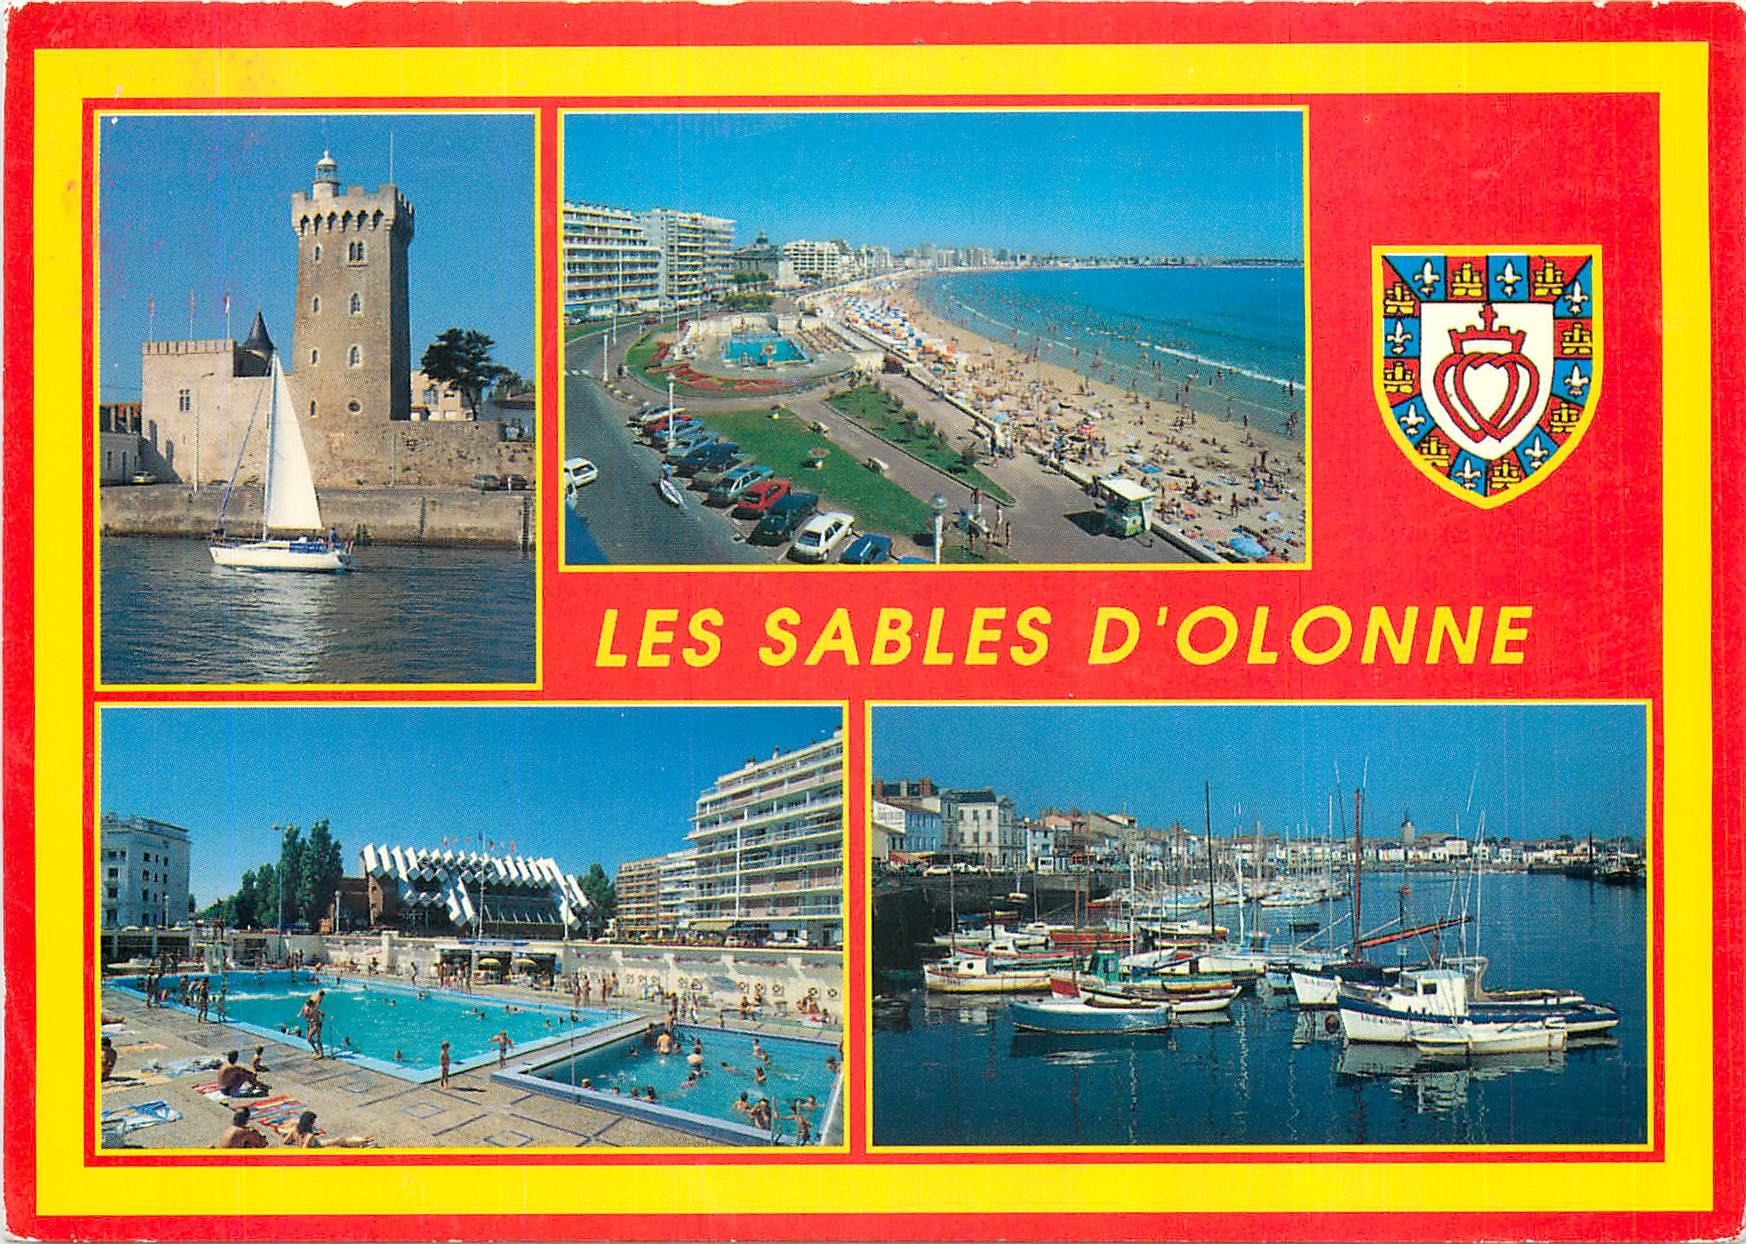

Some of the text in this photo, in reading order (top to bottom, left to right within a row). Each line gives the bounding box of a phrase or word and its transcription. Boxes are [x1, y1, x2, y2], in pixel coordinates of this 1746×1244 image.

[596, 605, 1534, 668] LES SABLES D'OLONNE
